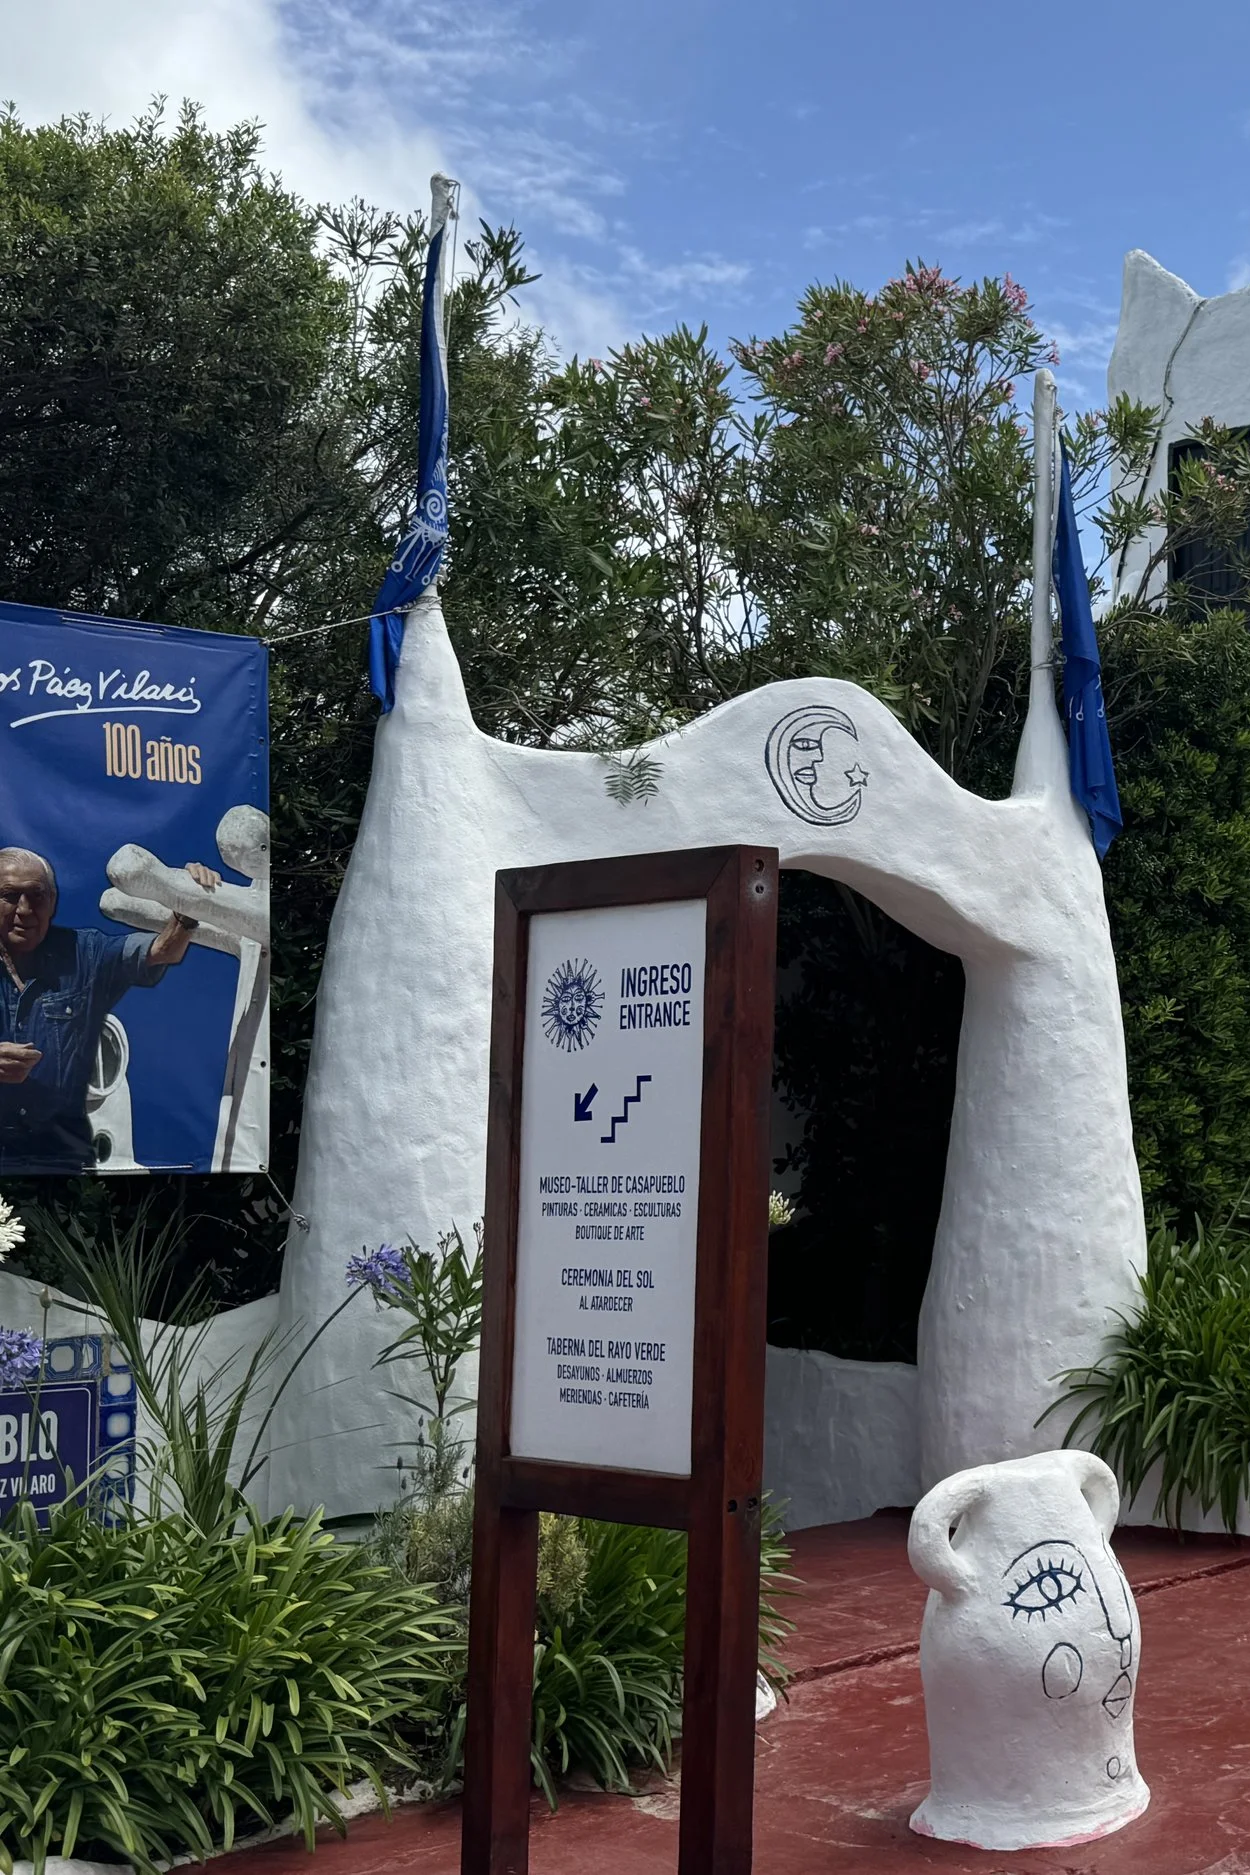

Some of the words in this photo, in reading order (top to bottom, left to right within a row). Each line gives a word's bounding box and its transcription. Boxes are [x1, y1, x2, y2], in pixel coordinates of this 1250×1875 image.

[102, 721, 142, 779] 100
[146, 735, 202, 785] años
[620, 962, 692, 998] INGRESO
[619, 1000, 691, 1030] ENTRANCE
[539, 1176, 609, 1194] MUSEO-TALLER
[611, 1176, 623, 1194] DE
[625, 1175, 685, 1194] CASAPUEBLO
[541, 1202, 578, 1217] PINTURAS
[583, 1202, 628, 1217] CERAMICAS
[633, 1202, 682, 1217] ESCULTURAS
[575, 1225, 612, 1240] BOUTIQUE
[613, 1226, 624, 1240] DE
[625, 1226, 645, 1241] ARTE
[561, 1268, 614, 1287] CEREMONIA
[616, 1270, 634, 1288] DEL
[636, 1270, 655, 1289] SOL
[578, 1295, 589, 1310] AL
[590, 1295, 634, 1312] ATARDECER
[546, 1336, 586, 1357] TABERNA
[588, 1339, 605, 1358] DEL
[607, 1340, 632, 1360] RAYO
[634, 1342, 666, 1362] VERDE
[557, 1364, 600, 1382] DESAYUNOS
[606, 1367, 653, 1385] ALMUERZOS
[559, 1387, 602, 1406] MERIENDAS
[608, 1390, 650, 1410] CAFETERÍA
